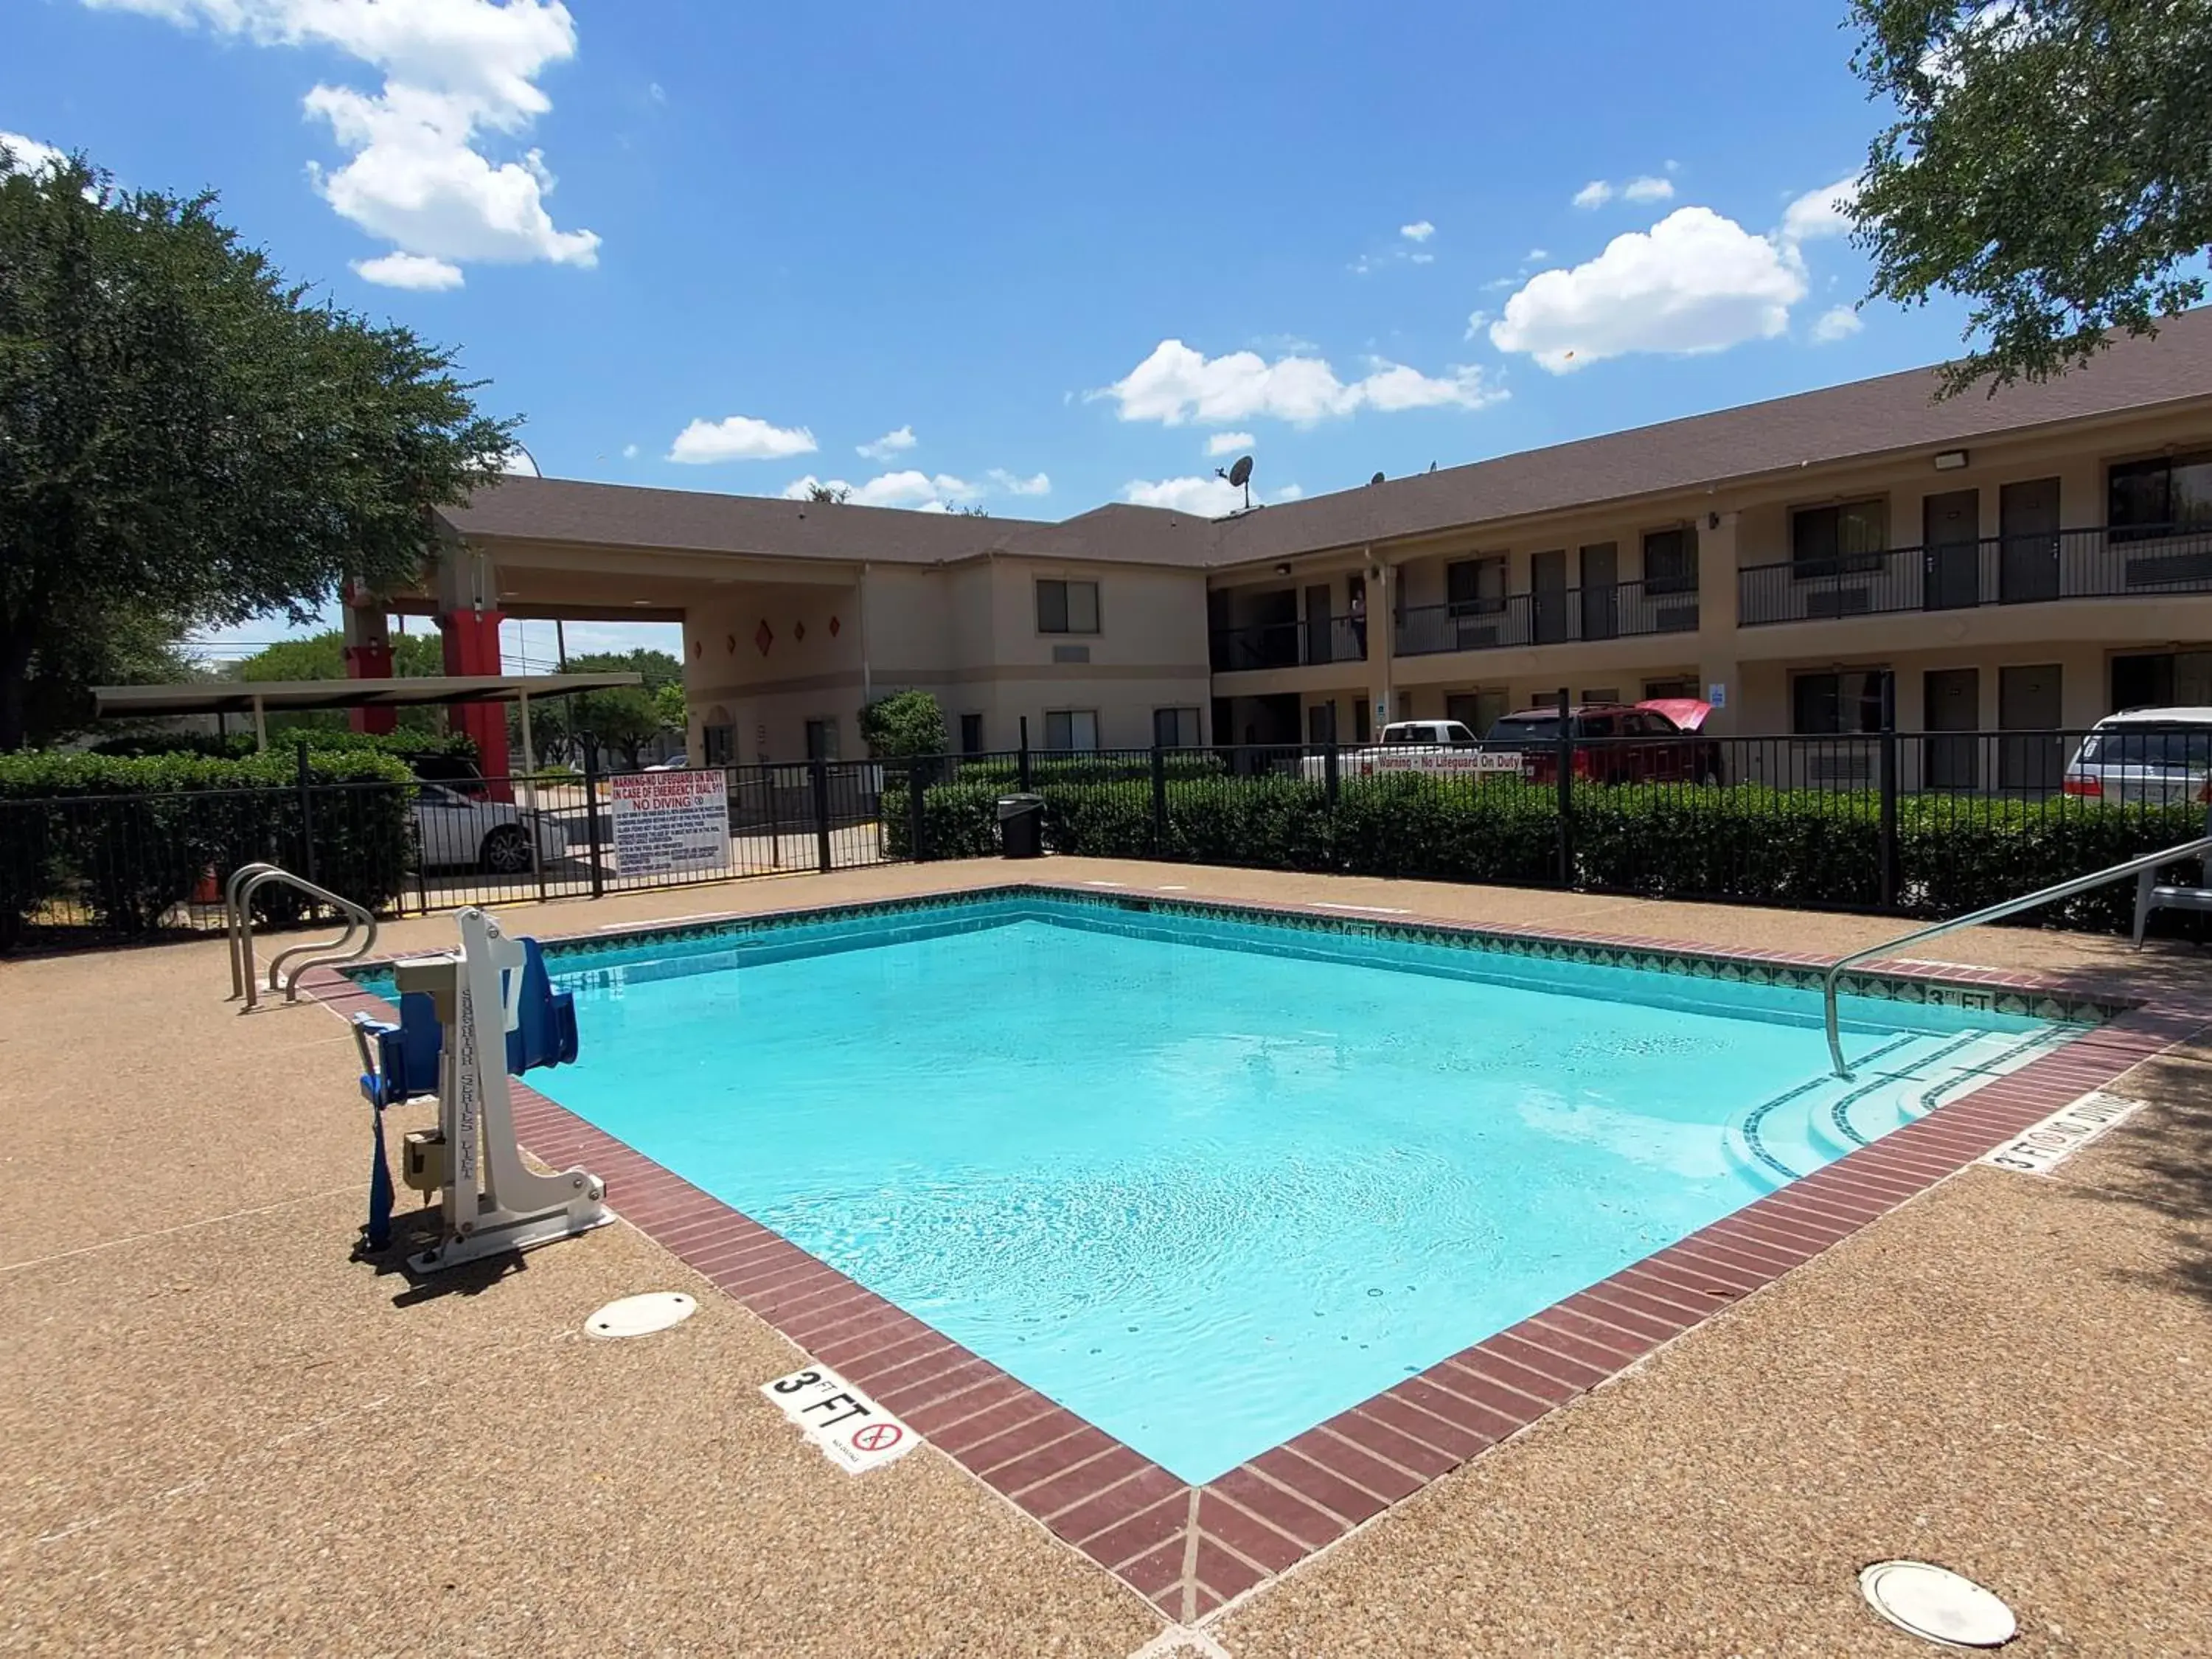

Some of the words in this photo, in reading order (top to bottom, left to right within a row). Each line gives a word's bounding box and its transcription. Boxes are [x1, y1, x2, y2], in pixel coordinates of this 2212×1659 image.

[1380, 756, 1412, 770] Warning
[1421, 756, 1433, 768] No
[1436, 755, 1478, 770] Lifeguard
[1481, 755, 1494, 768] On
[1498, 755, 1520, 768] Duty
[613, 790, 621, 799] IN
[622, 787, 640, 799] CASE
[642, 787, 652, 797] OF
[653, 784, 694, 796] EMERGENCY
[633, 799, 650, 810] NO
[653, 796, 690, 809] DIVING
[1962, 992, 1990, 1011] FT
[460, 1074, 473, 1133] SERIES
[2010, 1141, 2059, 1158] FT
[1993, 1156, 2035, 1169] 3
[773, 1371, 821, 1394] 3
[801, 1393, 872, 1428] FT
